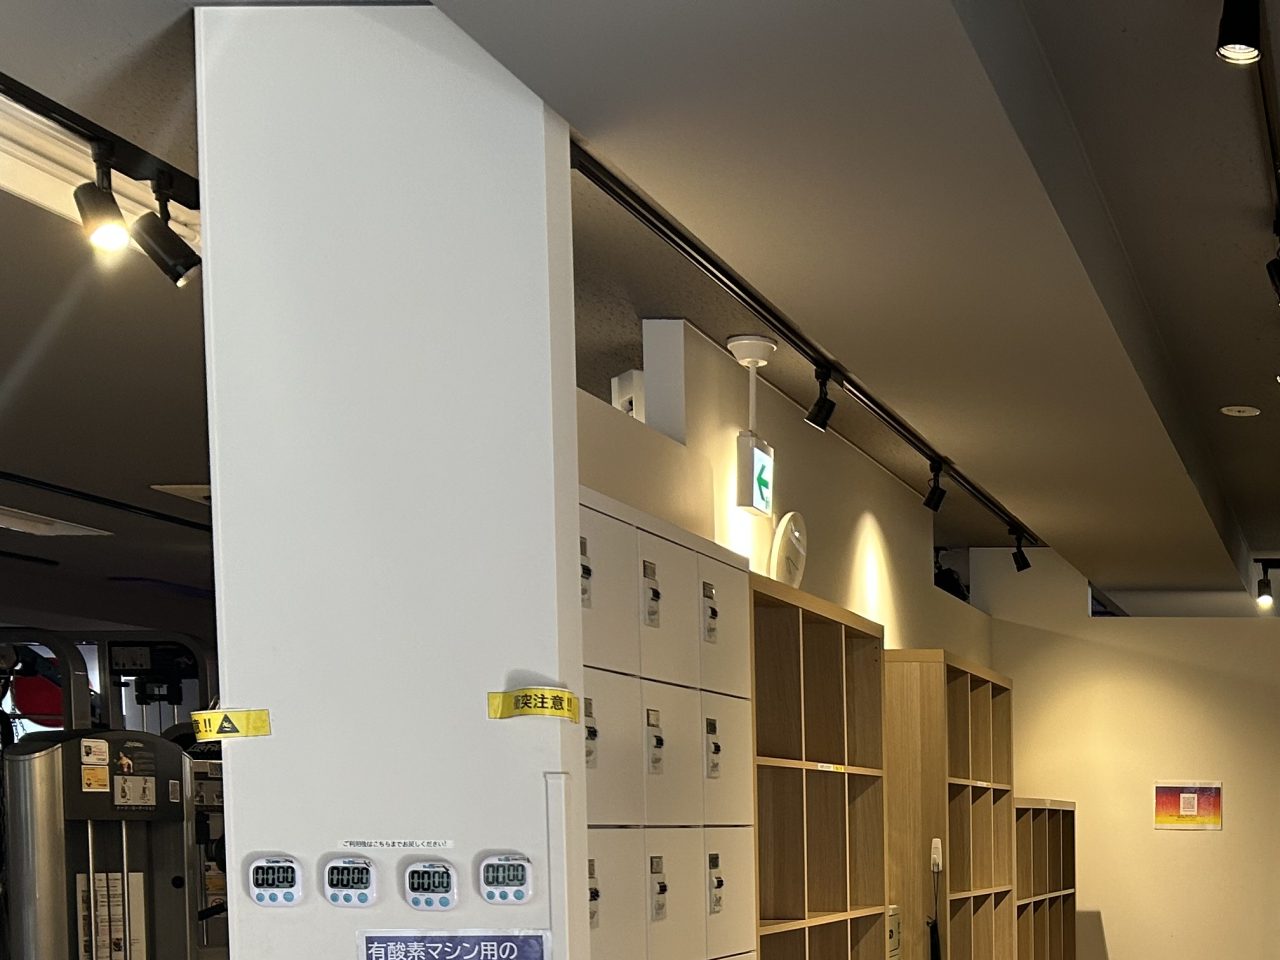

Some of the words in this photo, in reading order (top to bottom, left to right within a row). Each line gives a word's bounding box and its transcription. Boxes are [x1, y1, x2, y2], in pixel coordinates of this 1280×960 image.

[368, 941, 518, 960] 有酸素マシン用の
